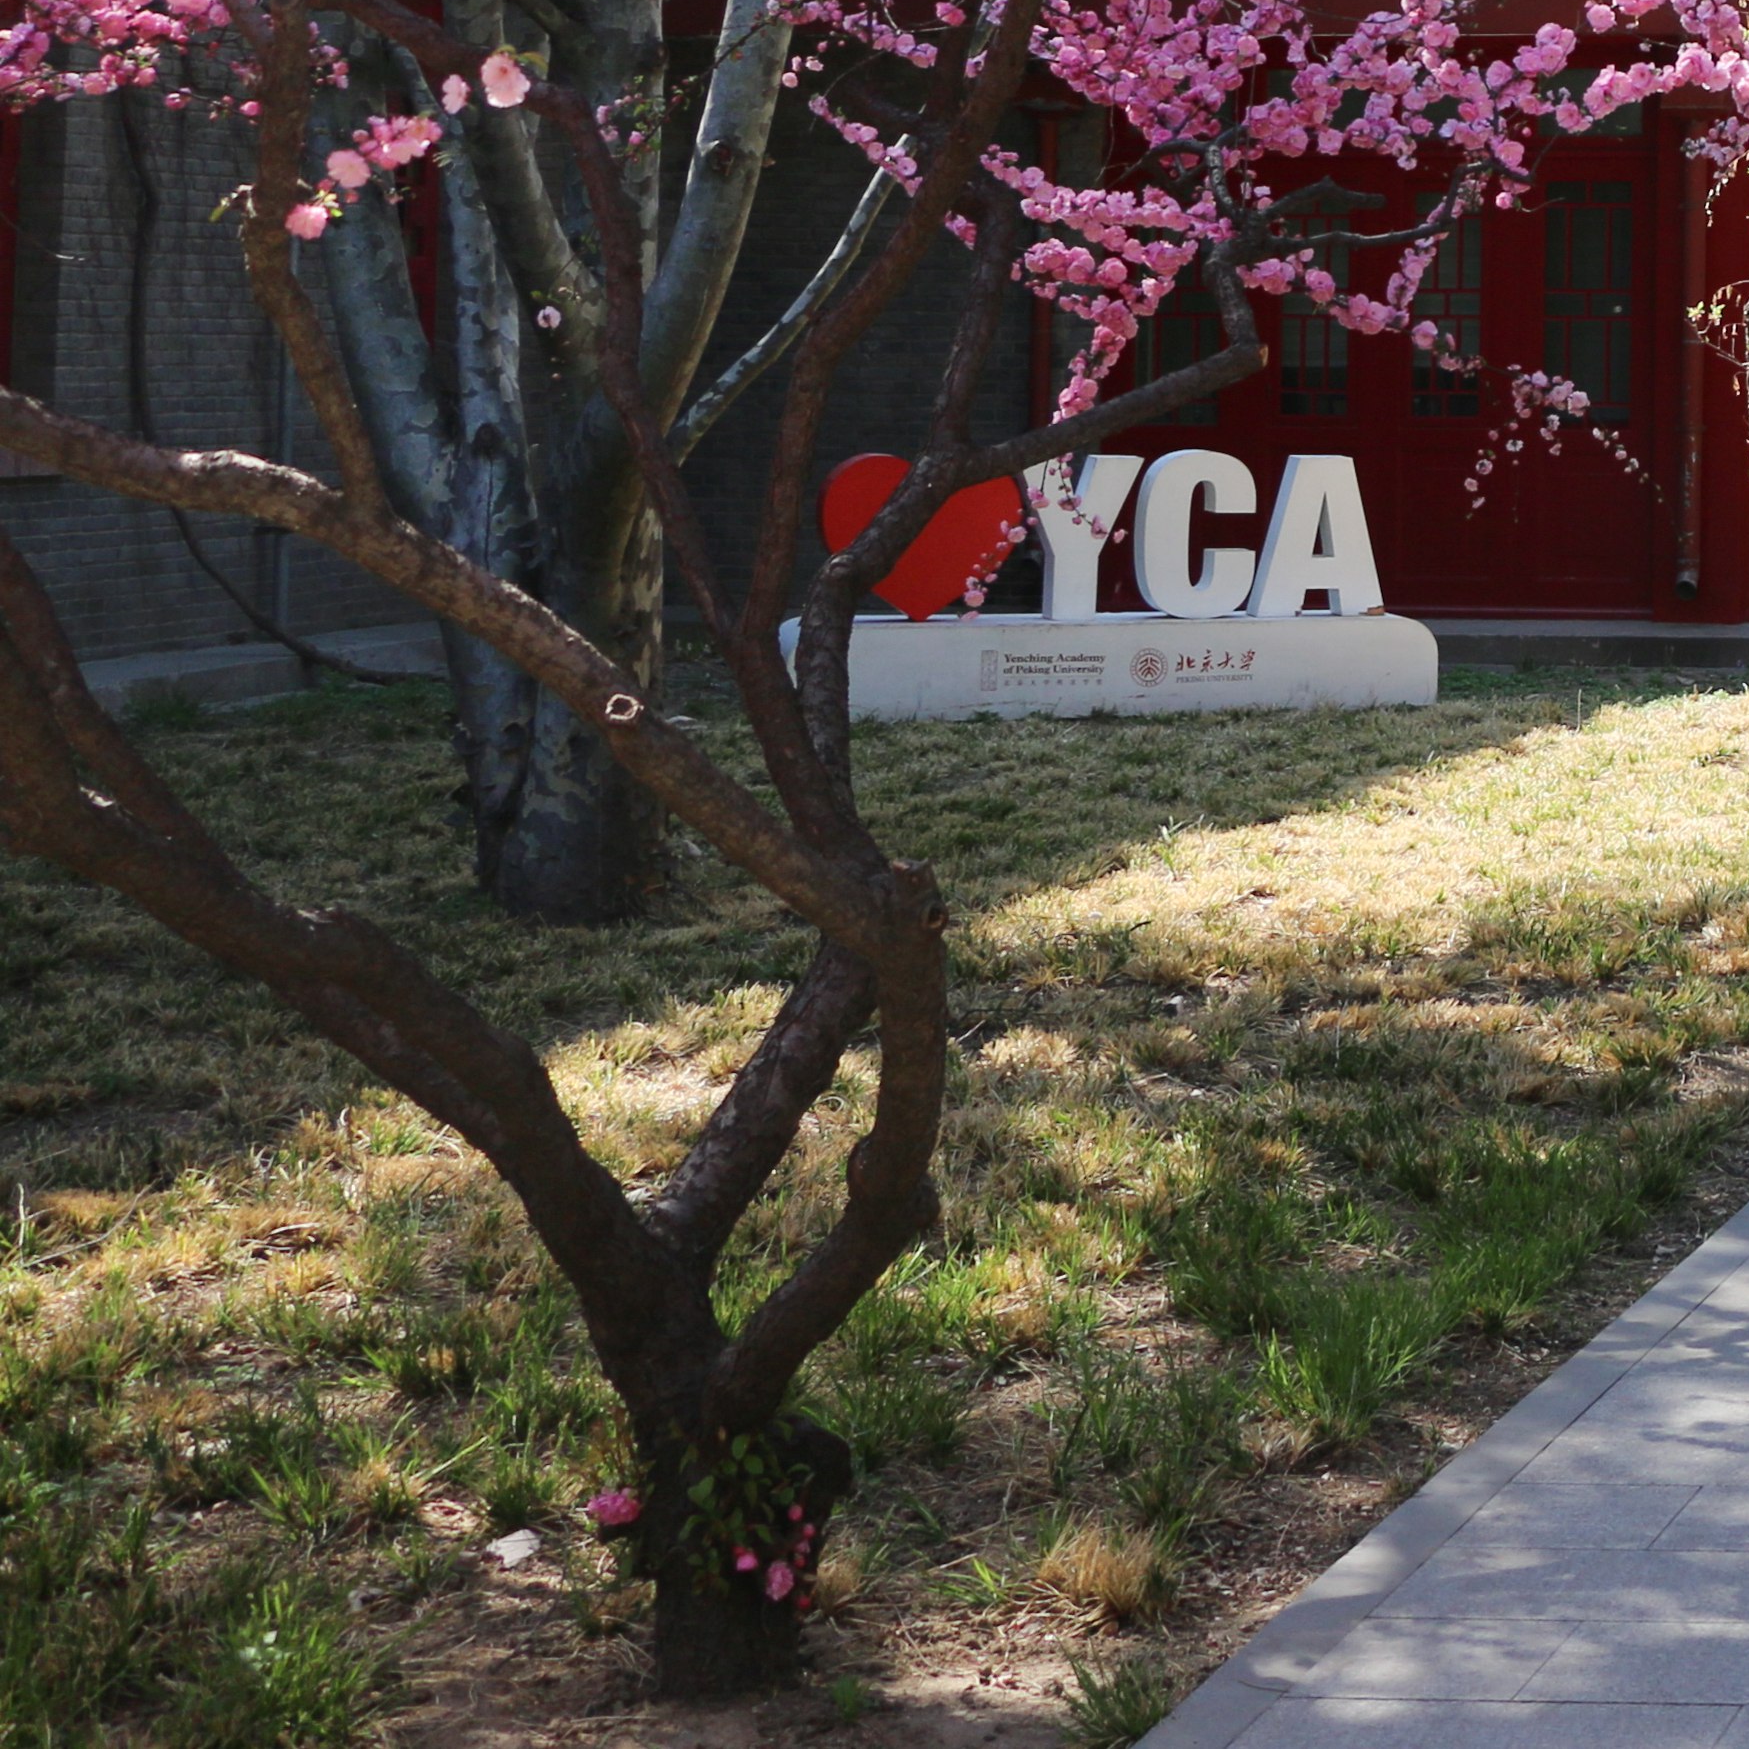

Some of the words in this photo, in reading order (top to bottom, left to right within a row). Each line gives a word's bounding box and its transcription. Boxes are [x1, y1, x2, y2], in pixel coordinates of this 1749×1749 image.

[1019, 449, 1385, 621] YCA
[1004, 653, 1054, 664] Yenching
[1056, 653, 1106, 664] Academy
[1003, 665, 1014, 674] of
[1016, 665, 1051, 675] Peking
[1053, 665, 1104, 675] University
